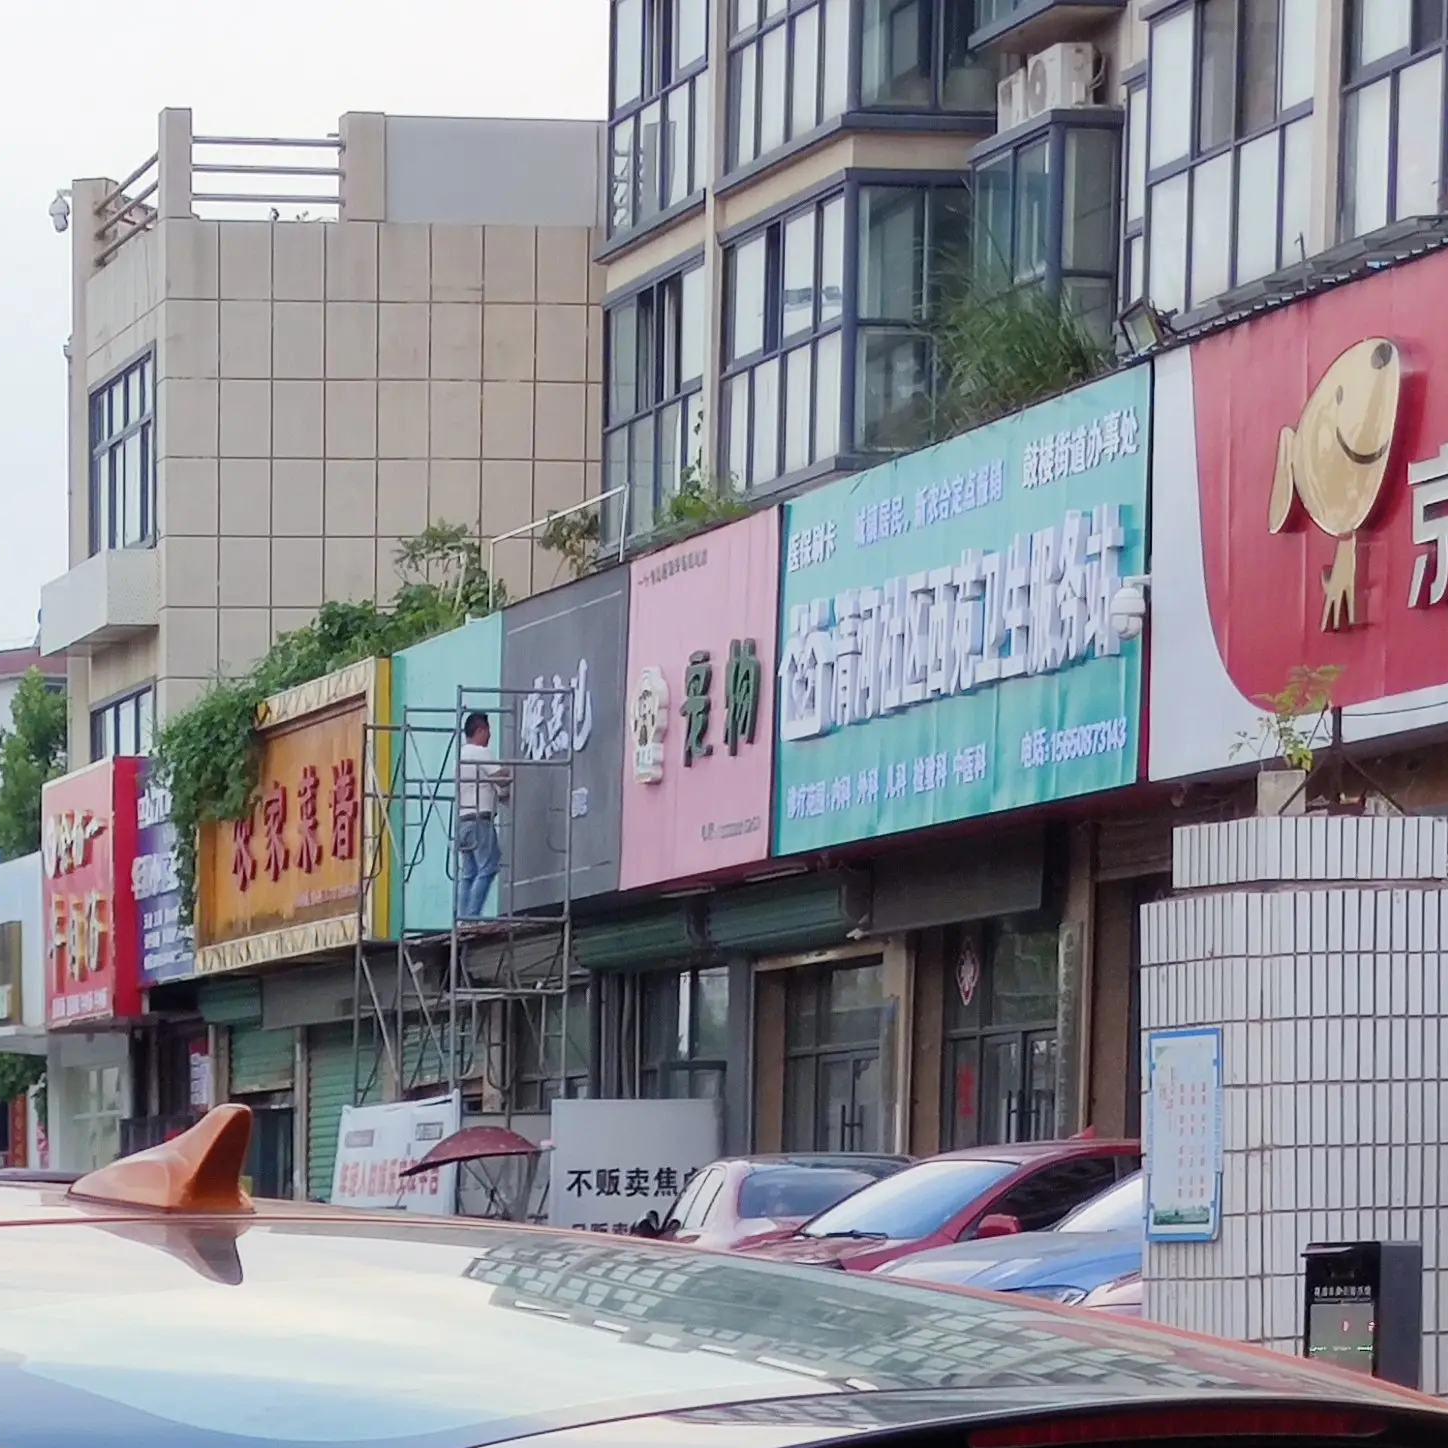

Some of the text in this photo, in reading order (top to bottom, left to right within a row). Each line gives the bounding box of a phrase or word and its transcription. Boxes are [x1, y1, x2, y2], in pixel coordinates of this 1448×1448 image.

[788, 523, 838, 574] 医保刷卡
[1022, 405, 1139, 489] 鼓楼街道办事处
[831, 503, 1124, 725] 清河社区西苑卫生服务站
[680, 637, 762, 769] 宠物
